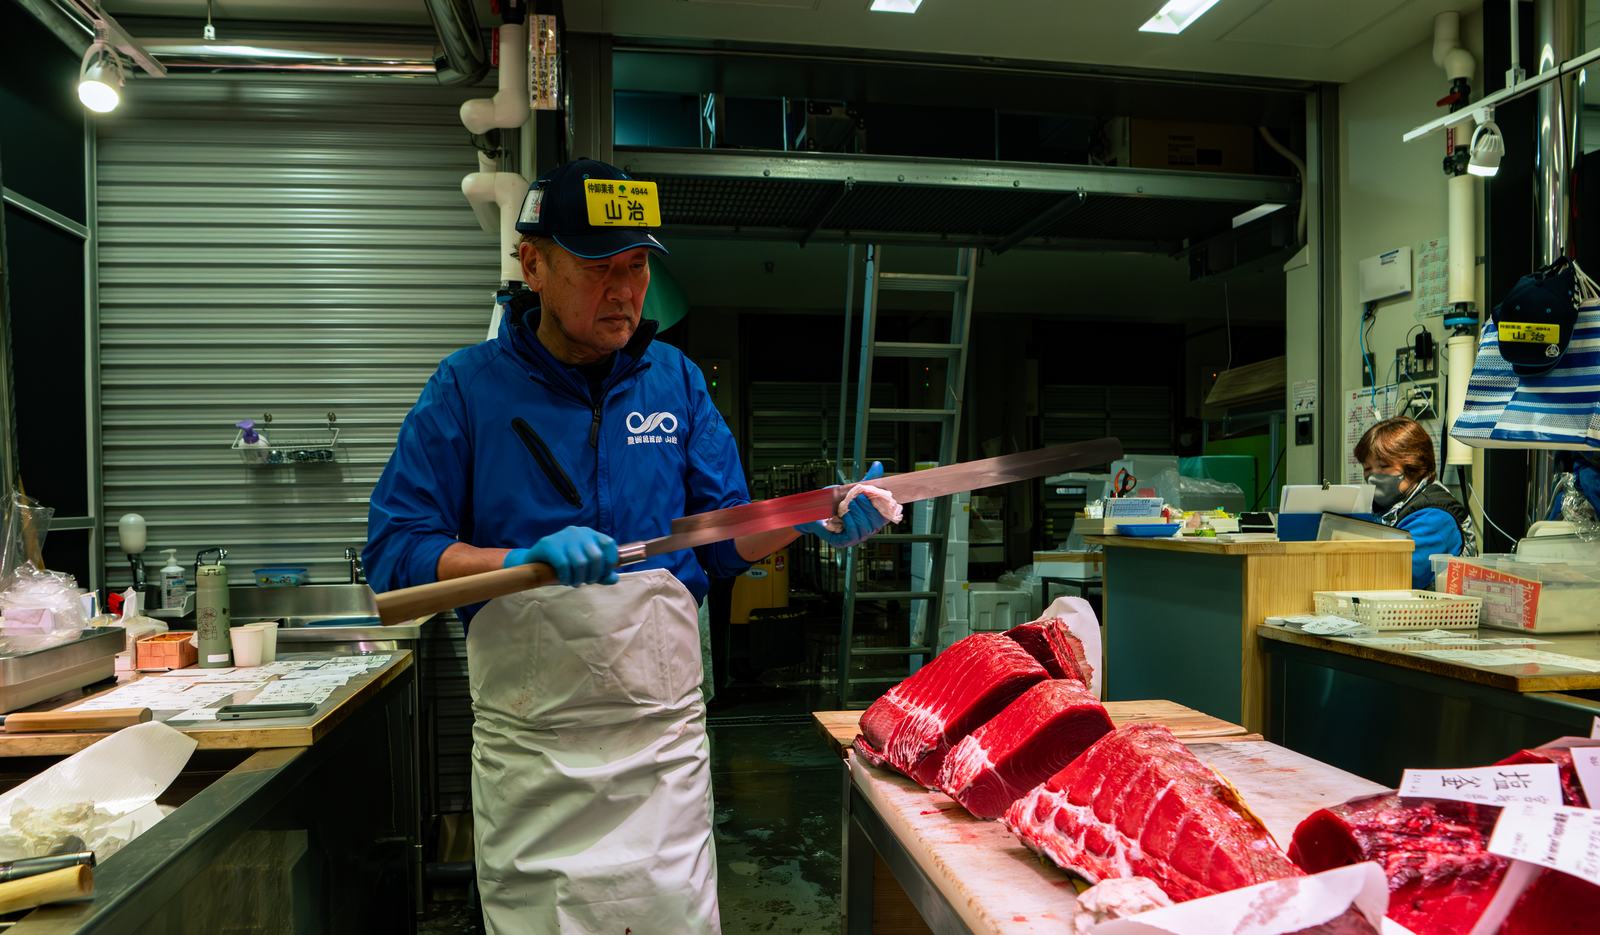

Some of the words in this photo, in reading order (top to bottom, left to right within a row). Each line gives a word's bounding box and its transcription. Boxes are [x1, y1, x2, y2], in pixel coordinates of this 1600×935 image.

[587, 183, 615, 194] 仲卸業者
[630, 187, 648, 196] 4944
[604, 199, 645, 221] 山治
[1512, 331, 1546, 342] 山治
